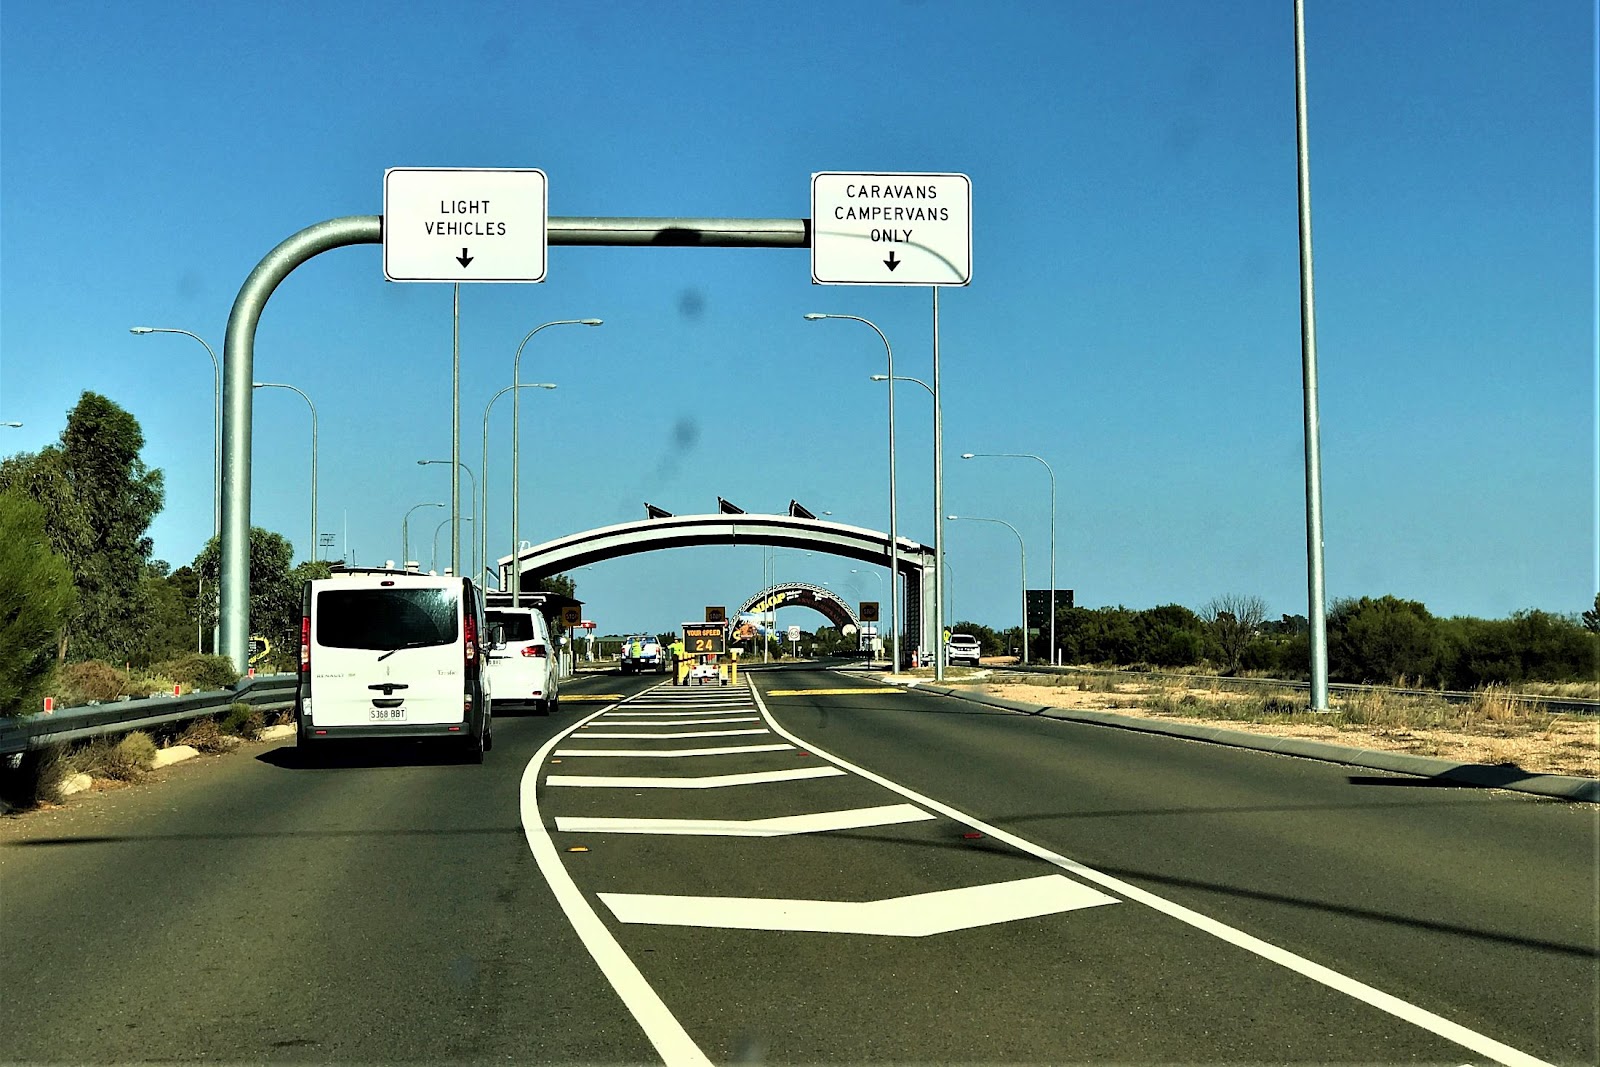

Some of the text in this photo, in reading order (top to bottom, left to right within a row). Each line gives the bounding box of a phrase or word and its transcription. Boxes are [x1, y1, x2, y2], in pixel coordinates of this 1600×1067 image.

[846, 184, 937, 199] CARAVANS
[441, 200, 490, 214] LIGHT
[834, 206, 949, 221] CAMPERVANS
[425, 221, 506, 236] VEHICLES
[870, 228, 913, 243] ONLY
[696, 639, 713, 651] 24
[390, 709, 405, 718] BBT
